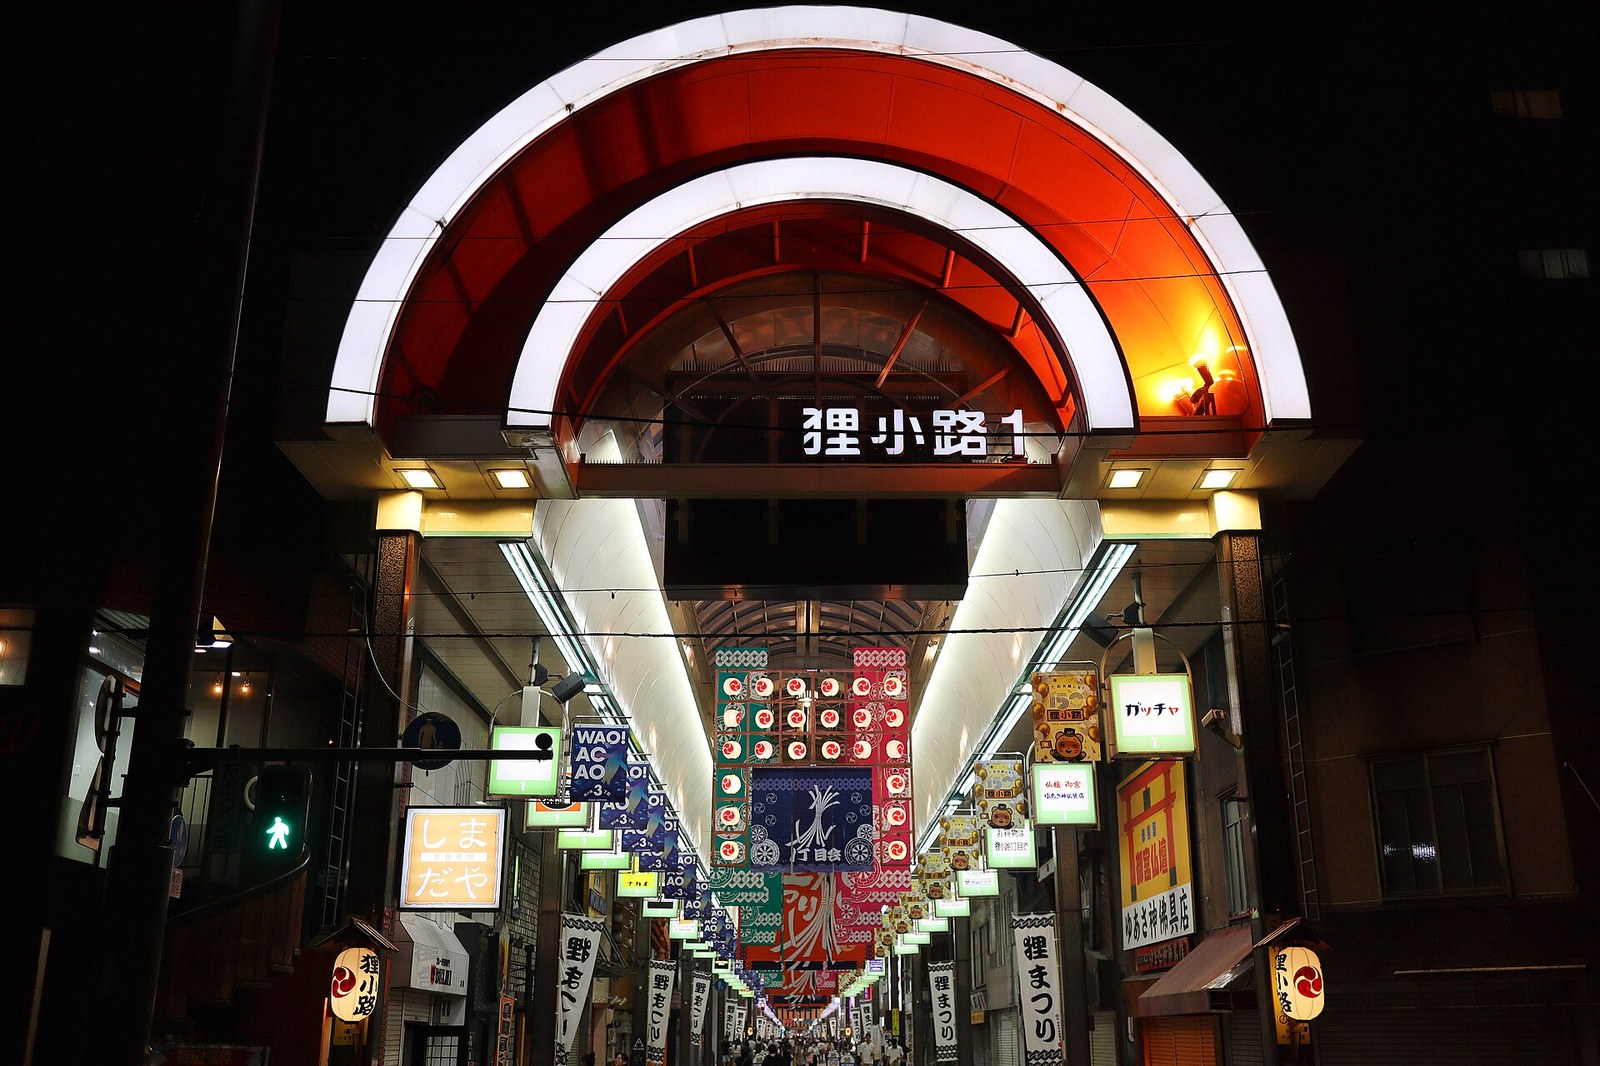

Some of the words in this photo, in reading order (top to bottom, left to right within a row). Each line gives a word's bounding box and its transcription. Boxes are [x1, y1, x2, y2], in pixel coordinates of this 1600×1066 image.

[1050, 711, 1081, 720] 狸小路
[1125, 702, 1180, 716] ガッチャ
[577, 730, 626, 745] WAO!
[574, 764, 606, 780] AO
[628, 764, 647, 779] O!
[649, 793, 664, 806] O!
[423, 818, 487, 849] しま
[678, 856, 696, 865] AO!
[414, 867, 488, 899] だや
[353, 954, 379, 1016] 狸小路
[1023, 936, 1056, 1042] 狸まつり
[935, 976, 953, 1041] 狸まつり
